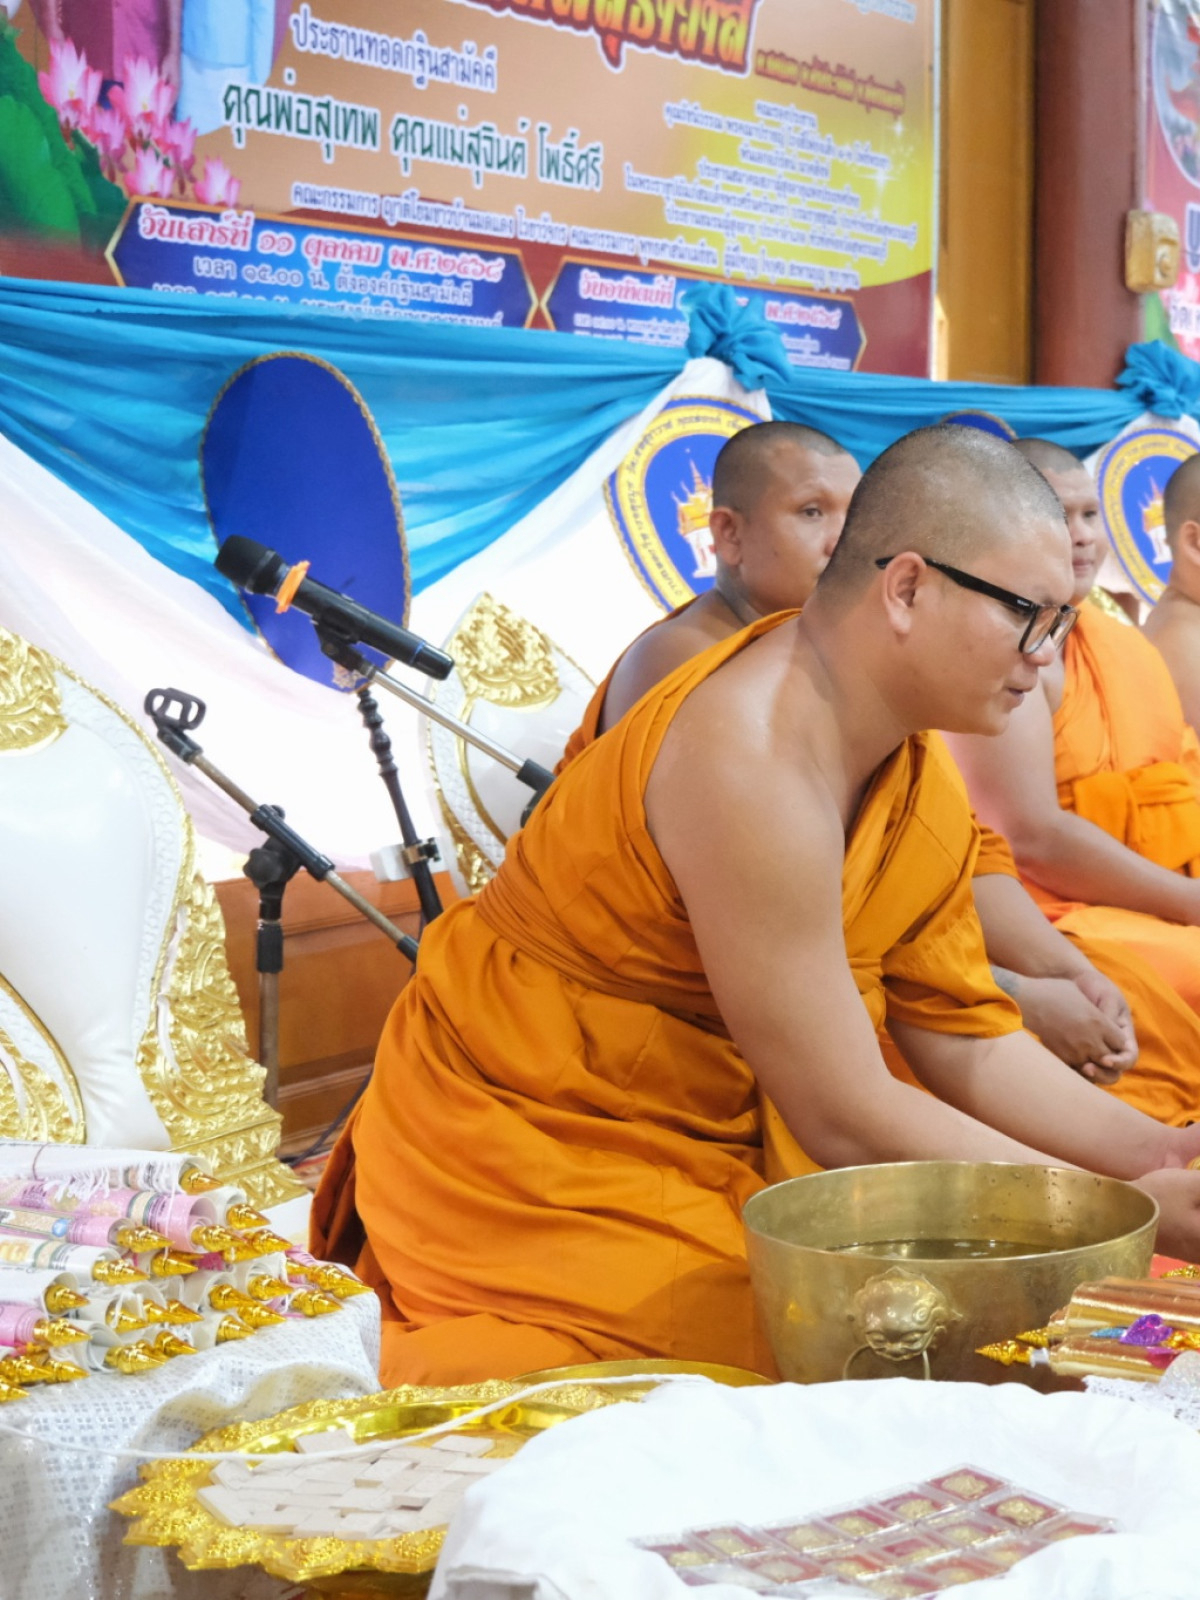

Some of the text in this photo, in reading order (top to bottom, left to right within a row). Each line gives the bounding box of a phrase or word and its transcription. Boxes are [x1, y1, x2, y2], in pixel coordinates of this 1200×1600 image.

[292, 6, 497, 90] ประธานทอดกฐินสามัคคี
[223, 72, 378, 159] คุณพ่อสุเทพ
[538, 126, 601, 188] โพธิ์ศรี
[293, 184, 380, 217] คณะกรรมการ
[140, 205, 504, 281] วันเสาร์ที่ ๑๑ ตุลาคม พ.ศ.๒๕๖๘
[194, 257, 236, 280] เวลา
[243, 264, 302, 287] ๑๕.๐๐
[309, 271, 330, 290] น.
